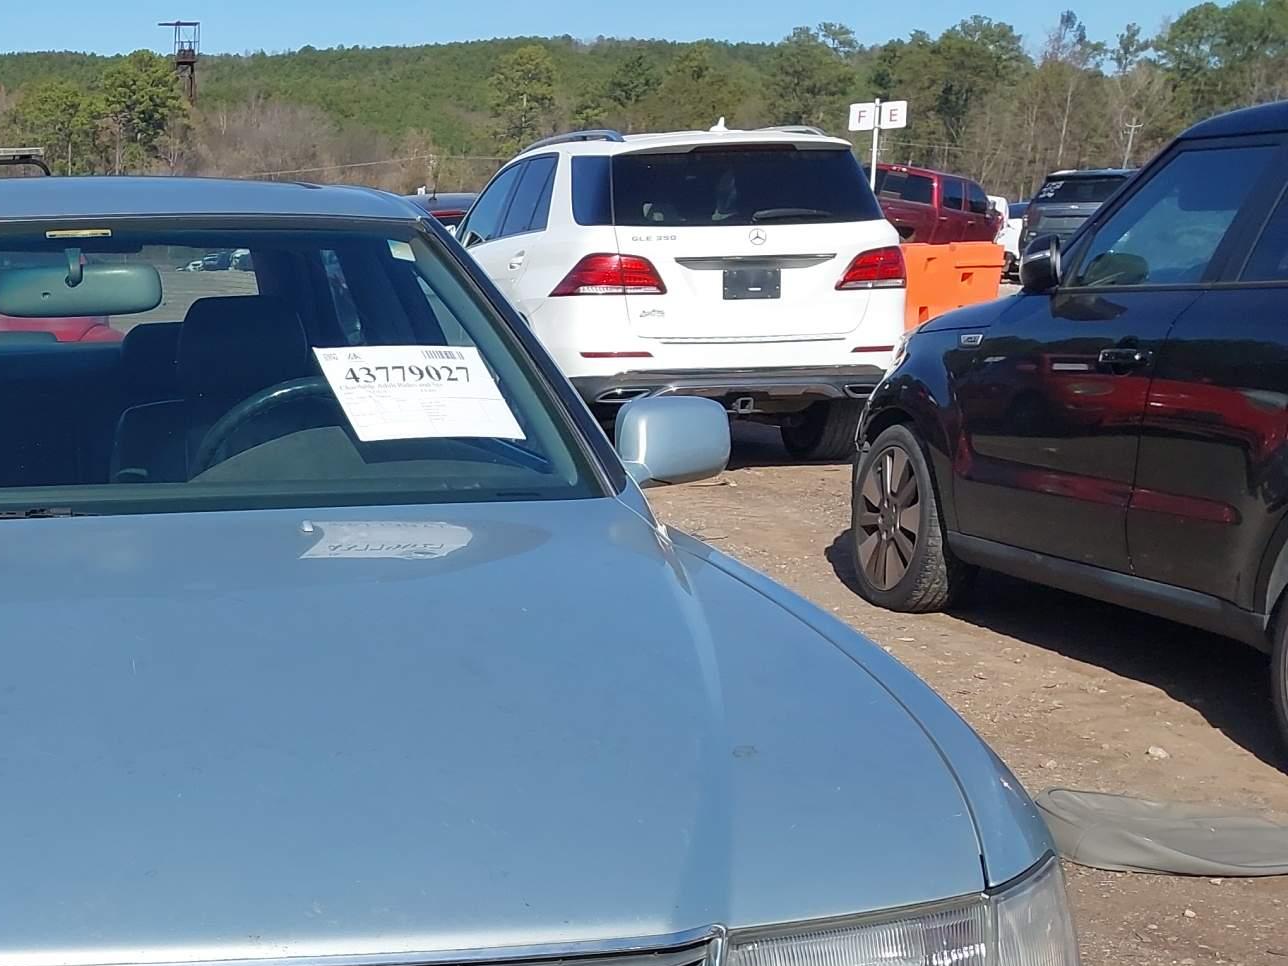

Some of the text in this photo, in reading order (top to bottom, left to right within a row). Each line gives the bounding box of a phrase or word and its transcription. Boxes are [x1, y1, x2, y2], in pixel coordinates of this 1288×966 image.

[857, 110, 867, 123] F
[889, 108, 899, 122] E
[344, 365, 470, 384] 43779027
